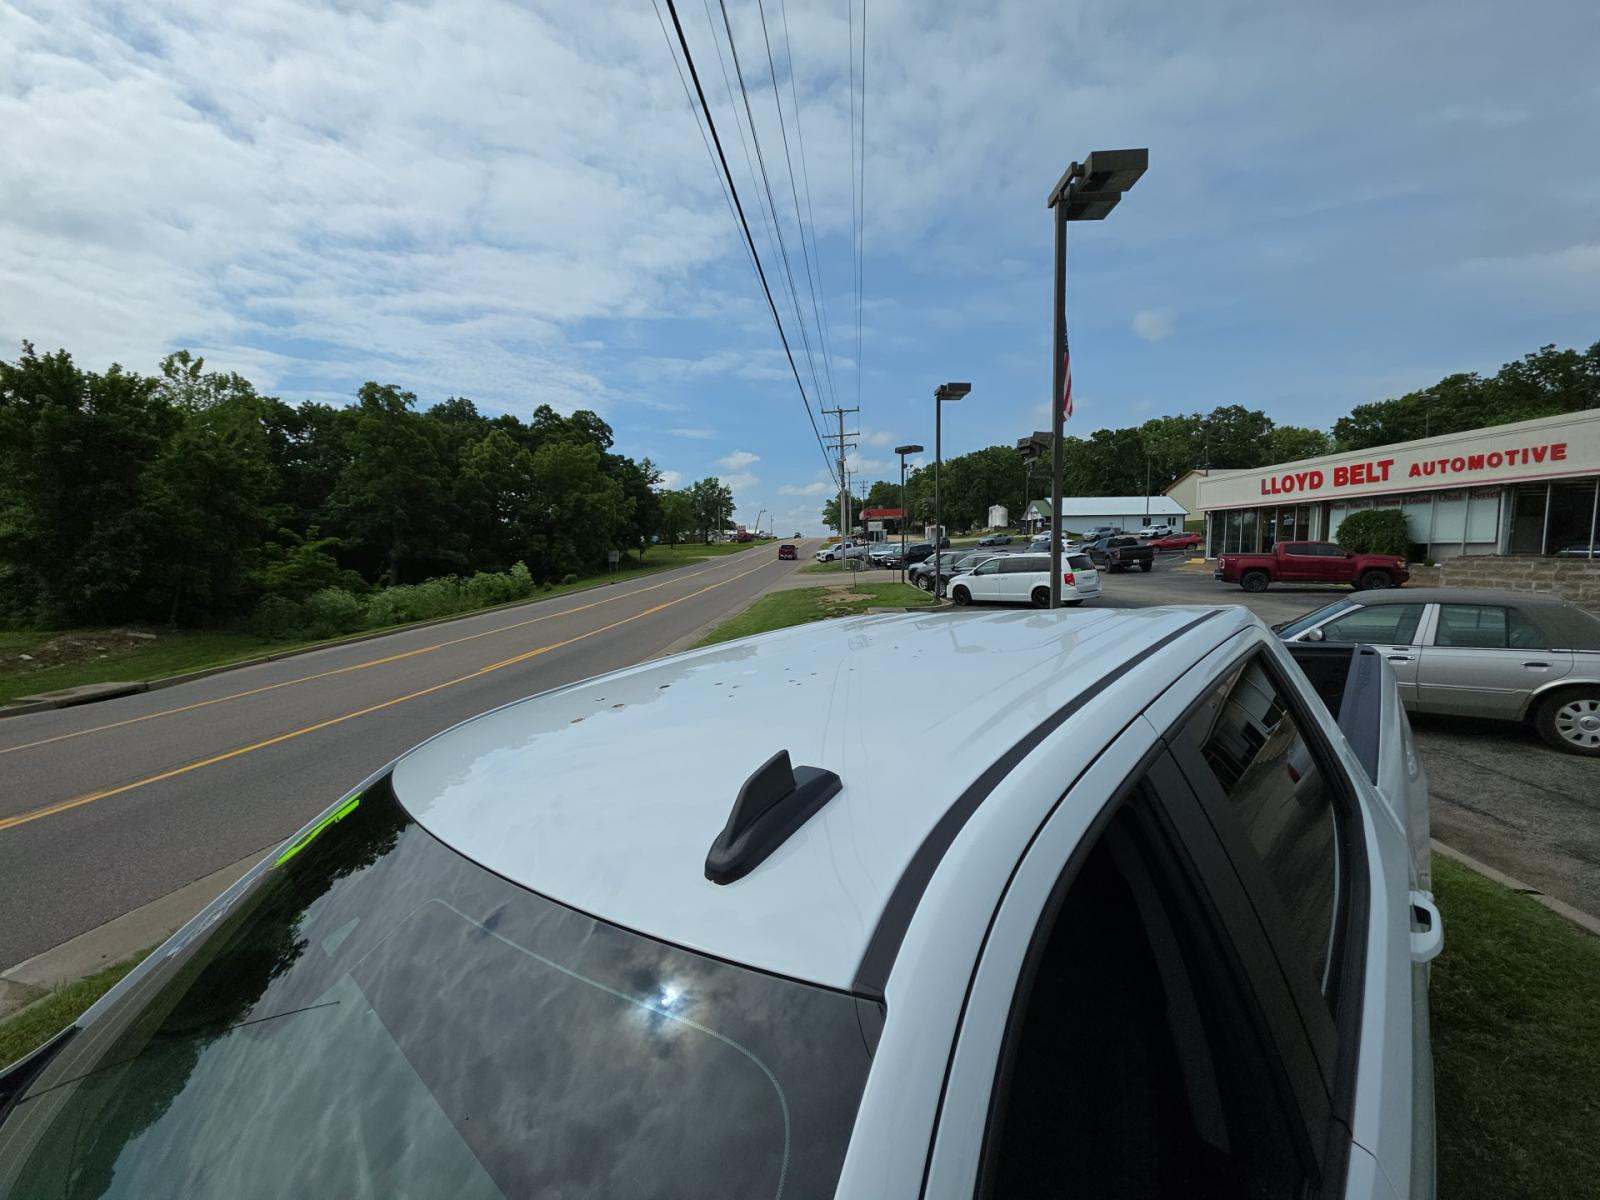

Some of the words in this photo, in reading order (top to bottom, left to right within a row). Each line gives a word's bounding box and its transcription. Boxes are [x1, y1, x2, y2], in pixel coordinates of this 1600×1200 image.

[1261, 470, 1324, 495] LLOYD
[1333, 459, 1394, 487] BELT
[1408, 443, 1567, 478] AUTOMOTIVE
